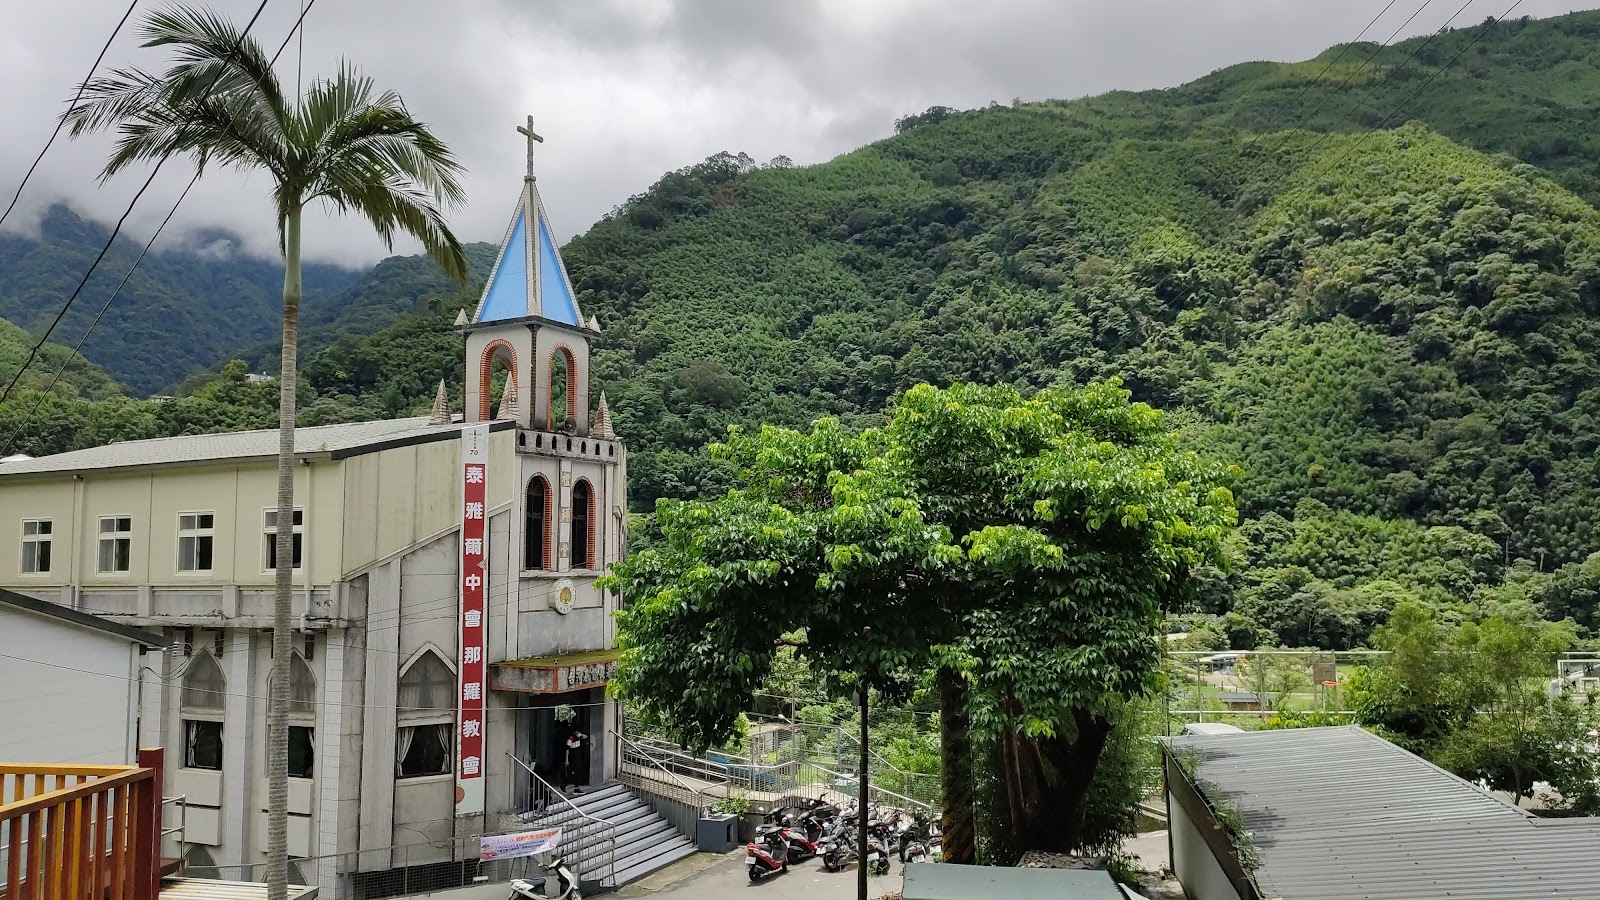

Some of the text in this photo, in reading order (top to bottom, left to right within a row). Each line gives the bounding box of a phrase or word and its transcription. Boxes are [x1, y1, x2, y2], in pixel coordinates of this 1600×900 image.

[462, 466, 484, 775] 泰雅爾中會那羅教會
